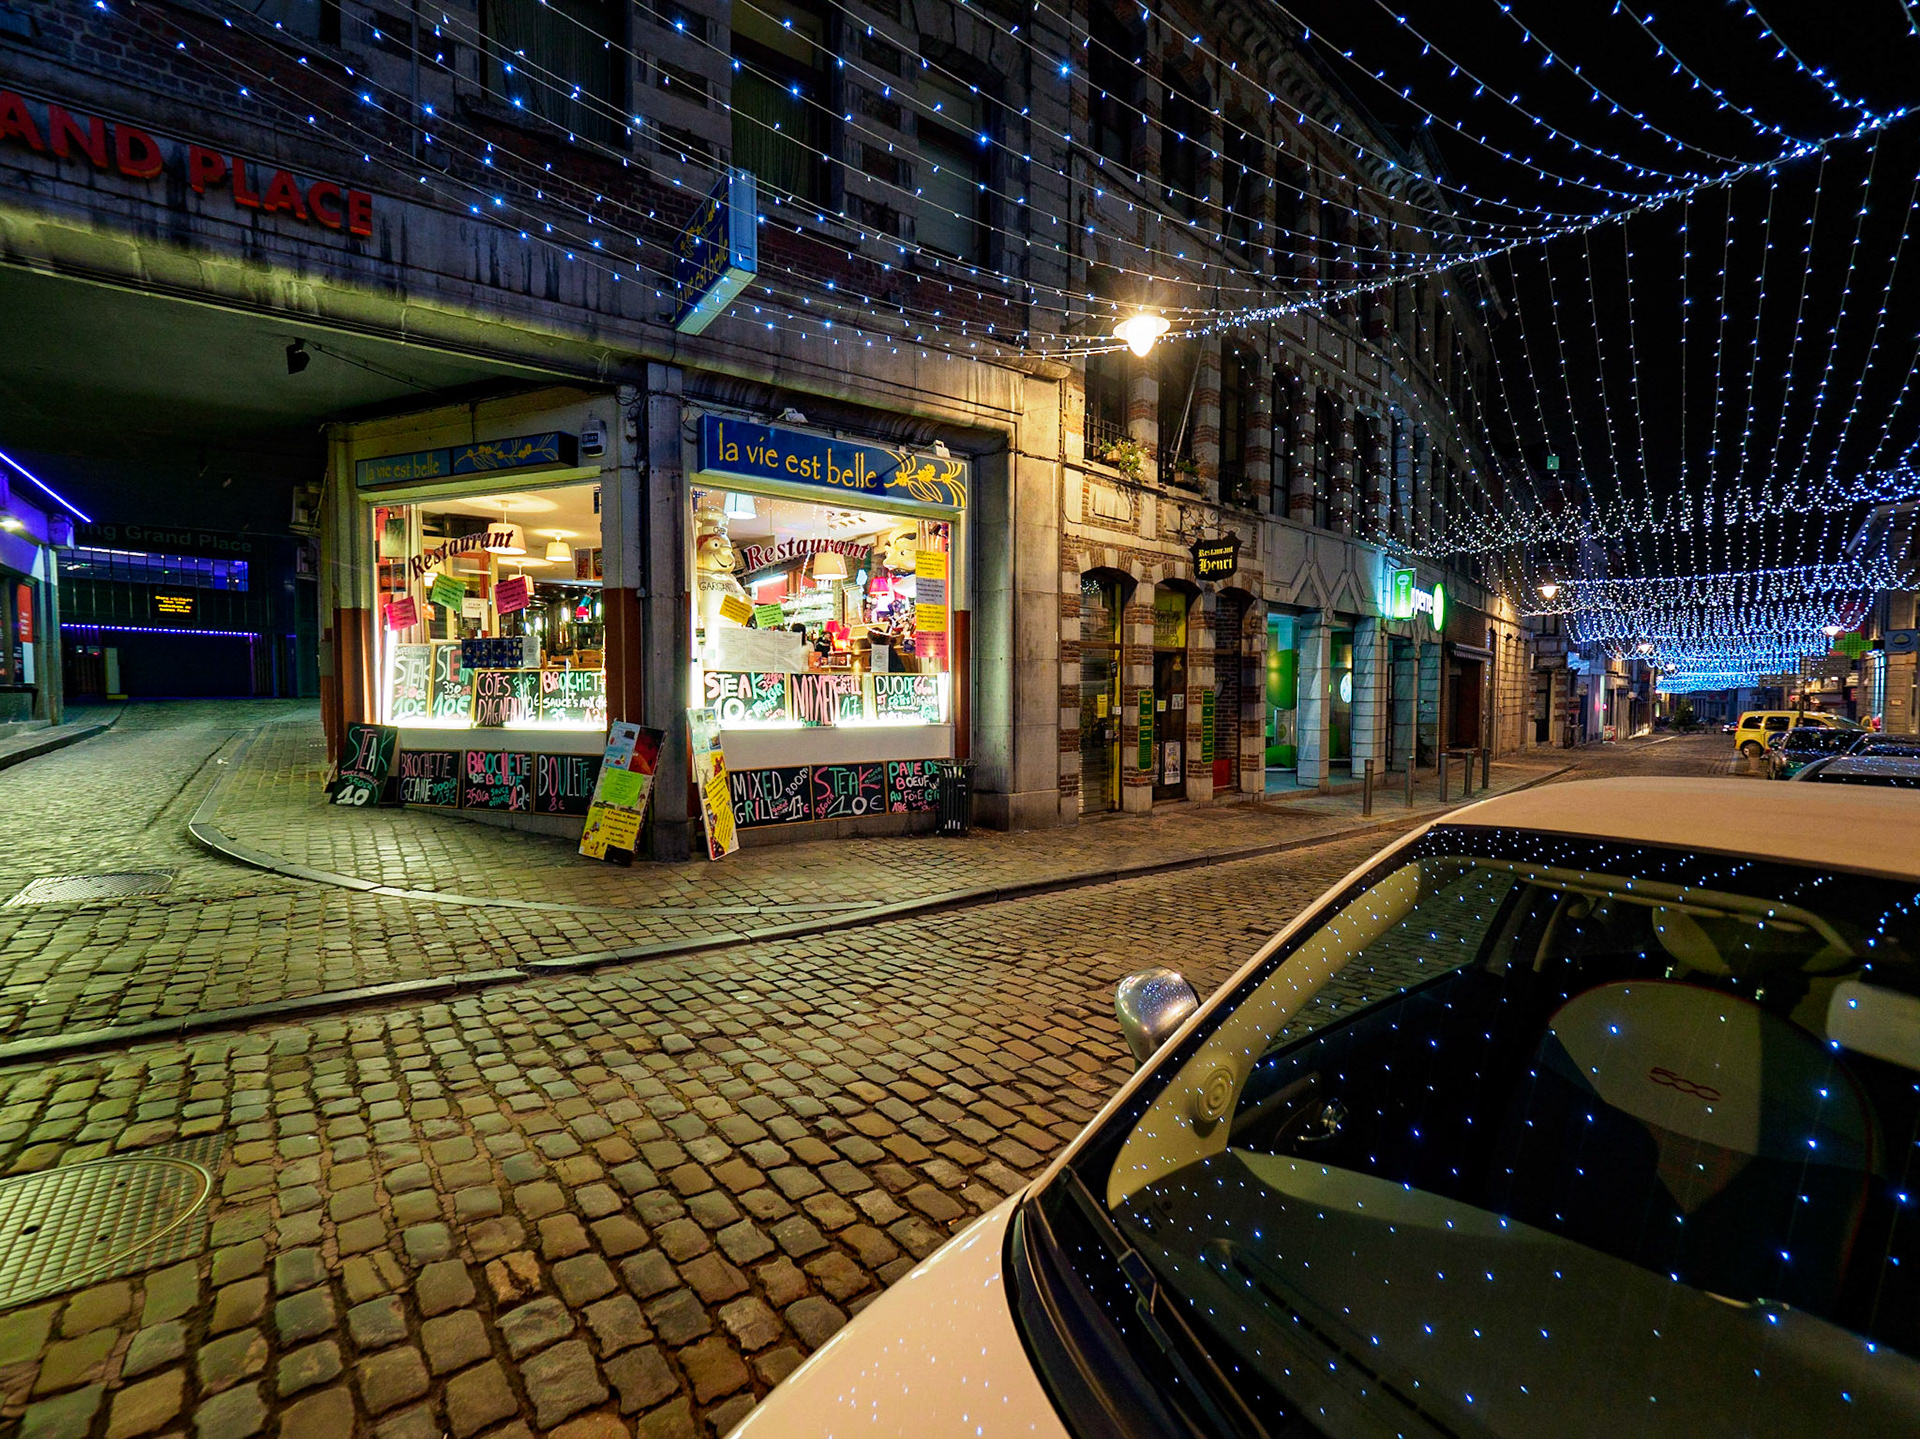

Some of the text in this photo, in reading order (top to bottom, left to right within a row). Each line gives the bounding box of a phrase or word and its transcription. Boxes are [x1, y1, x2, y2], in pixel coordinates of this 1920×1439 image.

[189, 144, 373, 237] PLACE
[365, 452, 440, 480] la vie est belle
[719, 422, 878, 489] la vie est belle
[125, 525, 193, 546] Grand
[199, 534, 253, 554] Place
[1198, 546, 1234, 558] Restaurant
[410, 529, 514, 581] Restaurant
[744, 537, 872, 573] Restaurant
[1198, 556, 1233, 574] Henri
[394, 656, 431, 690] STEAK
[477, 672, 511, 697] CÔTES
[704, 672, 767, 700] STEAK
[875, 675, 904, 695] DUO
[433, 691, 472, 719] 10€
[542, 698, 579, 709] SAUCES
[341, 726, 394, 777] STEAK
[400, 752, 453, 779] BROCHETTE
[466, 751, 531, 776] BROCHETTE
[472, 773, 525, 786] DE BOEUF
[538, 754, 595, 798] BOULETTES
[814, 765, 881, 801] STEAK
[888, 761, 923, 784] PAVE
[923, 760, 939, 775] DE
[895, 774, 930, 790] BOEUF
[336, 784, 370, 806] 10
[732, 771, 783, 802] MIXED
[890, 790, 902, 802] AU
[903, 789, 924, 803] FOIE
[734, 797, 779, 825] GRILL
[827, 794, 884, 818] 10€
